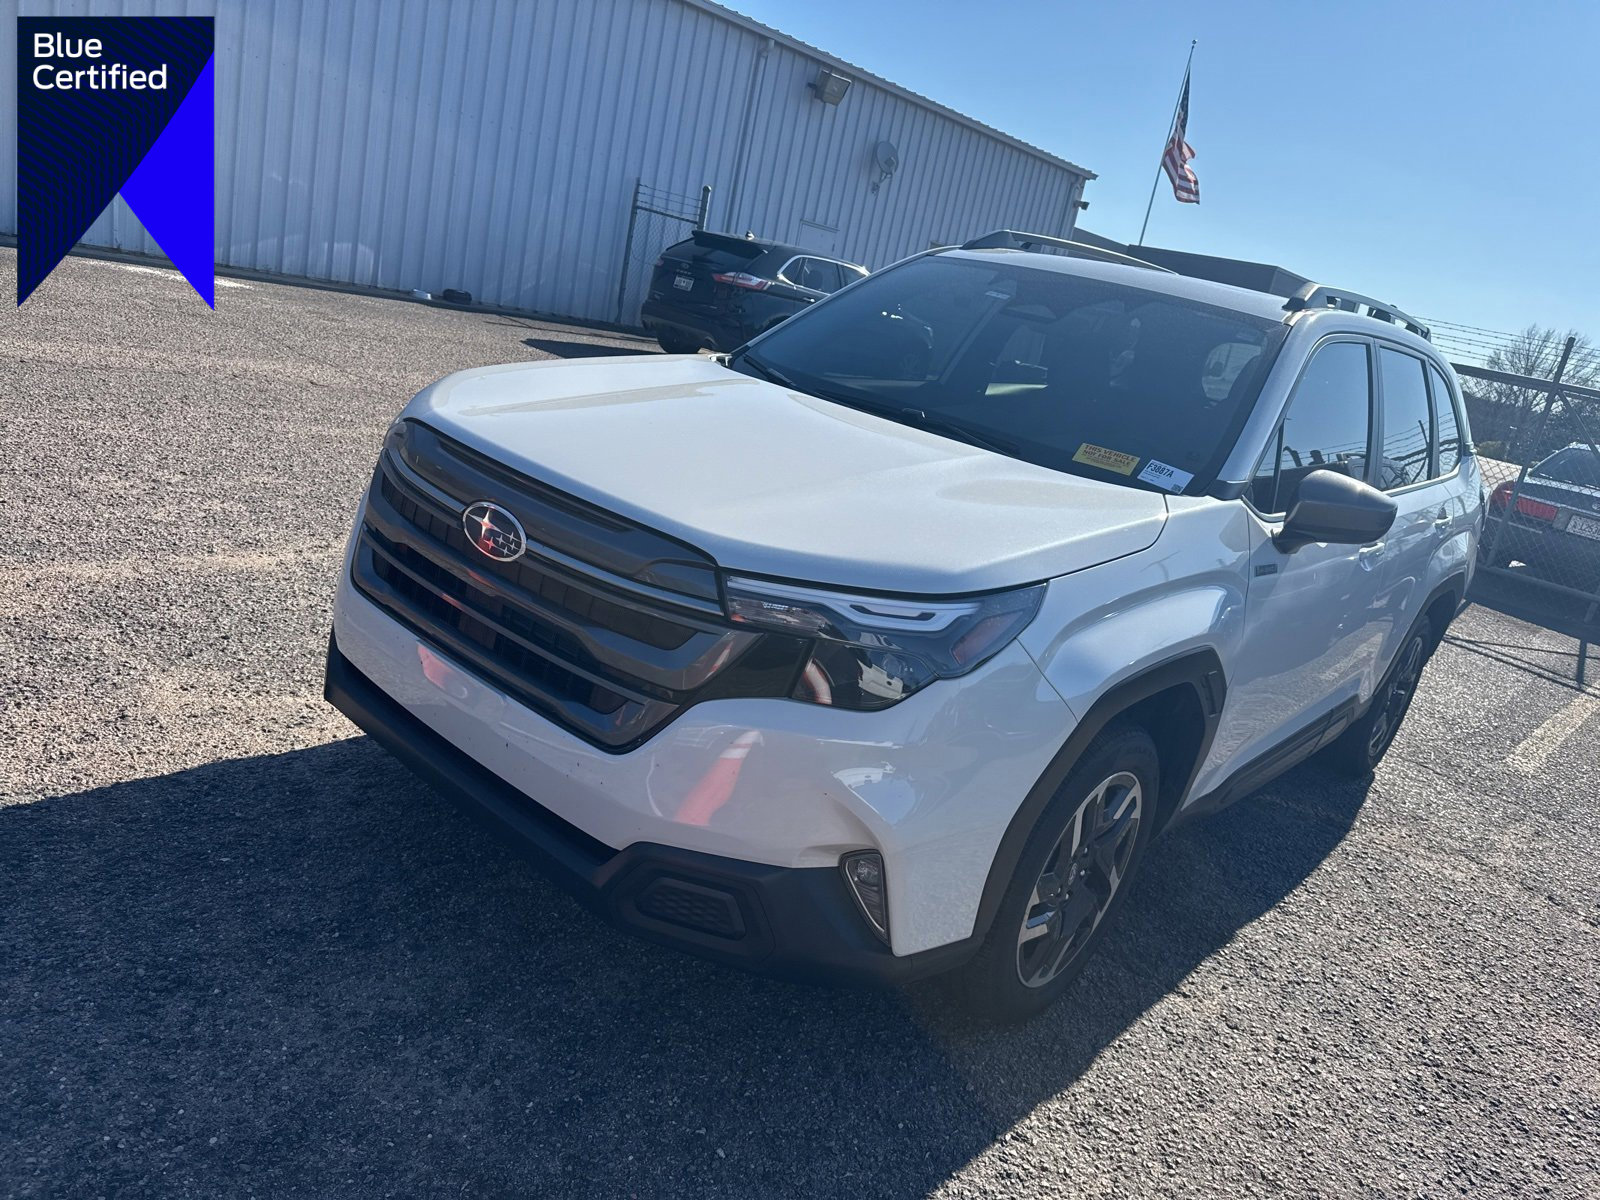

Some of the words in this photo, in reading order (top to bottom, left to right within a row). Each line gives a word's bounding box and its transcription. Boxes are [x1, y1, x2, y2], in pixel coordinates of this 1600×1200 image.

[1083, 449, 1097, 457] NOT
[1098, 453, 1113, 461] FOR
[1114, 457, 1132, 466] SALE
[1085, 444, 1102, 453] THIS
[1103, 449, 1136, 462] VEHICLE
[1146, 462, 1175, 478] F3887A
